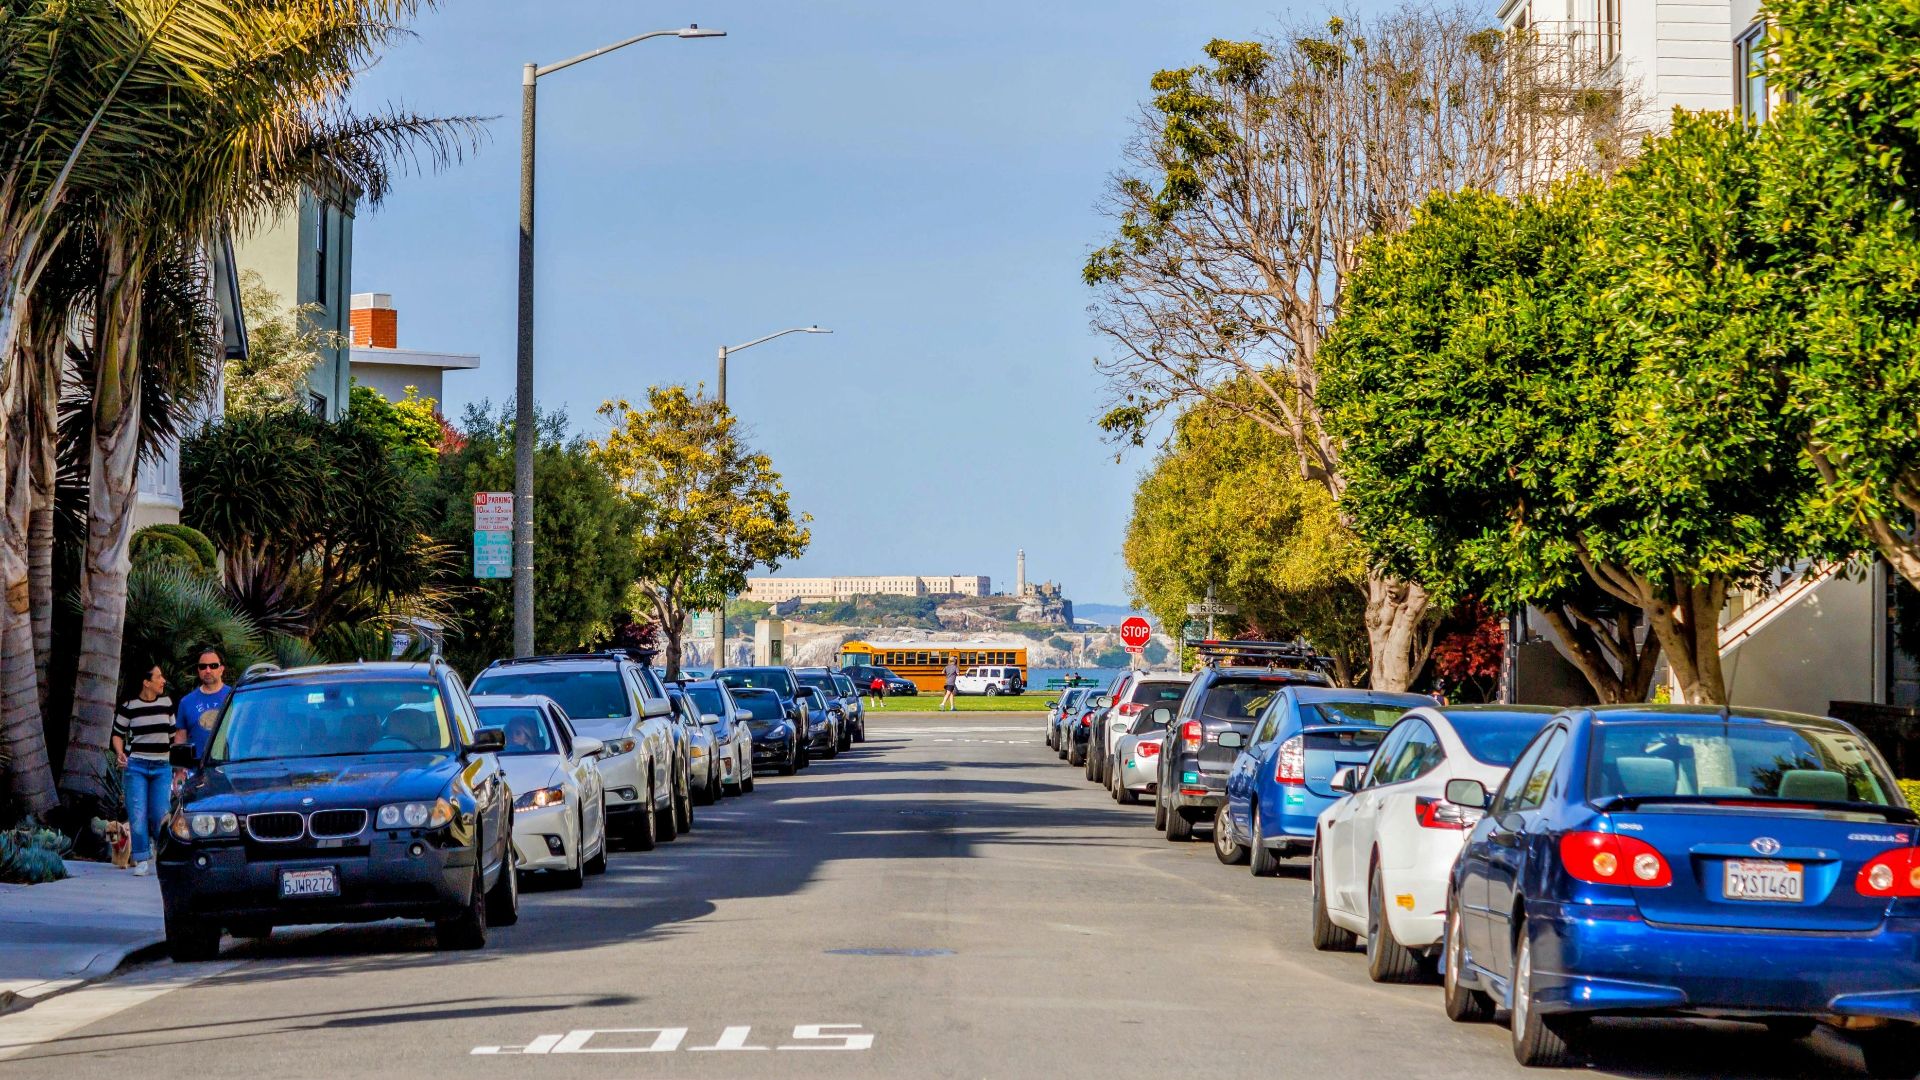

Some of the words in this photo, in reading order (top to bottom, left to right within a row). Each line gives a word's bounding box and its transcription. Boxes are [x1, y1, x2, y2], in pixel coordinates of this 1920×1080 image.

[1122, 625, 1149, 638] STOP
[284, 877, 333, 894] 5JWR272
[1730, 873, 1798, 895] 7XST460
[470, 1024, 875, 1055] STOP
